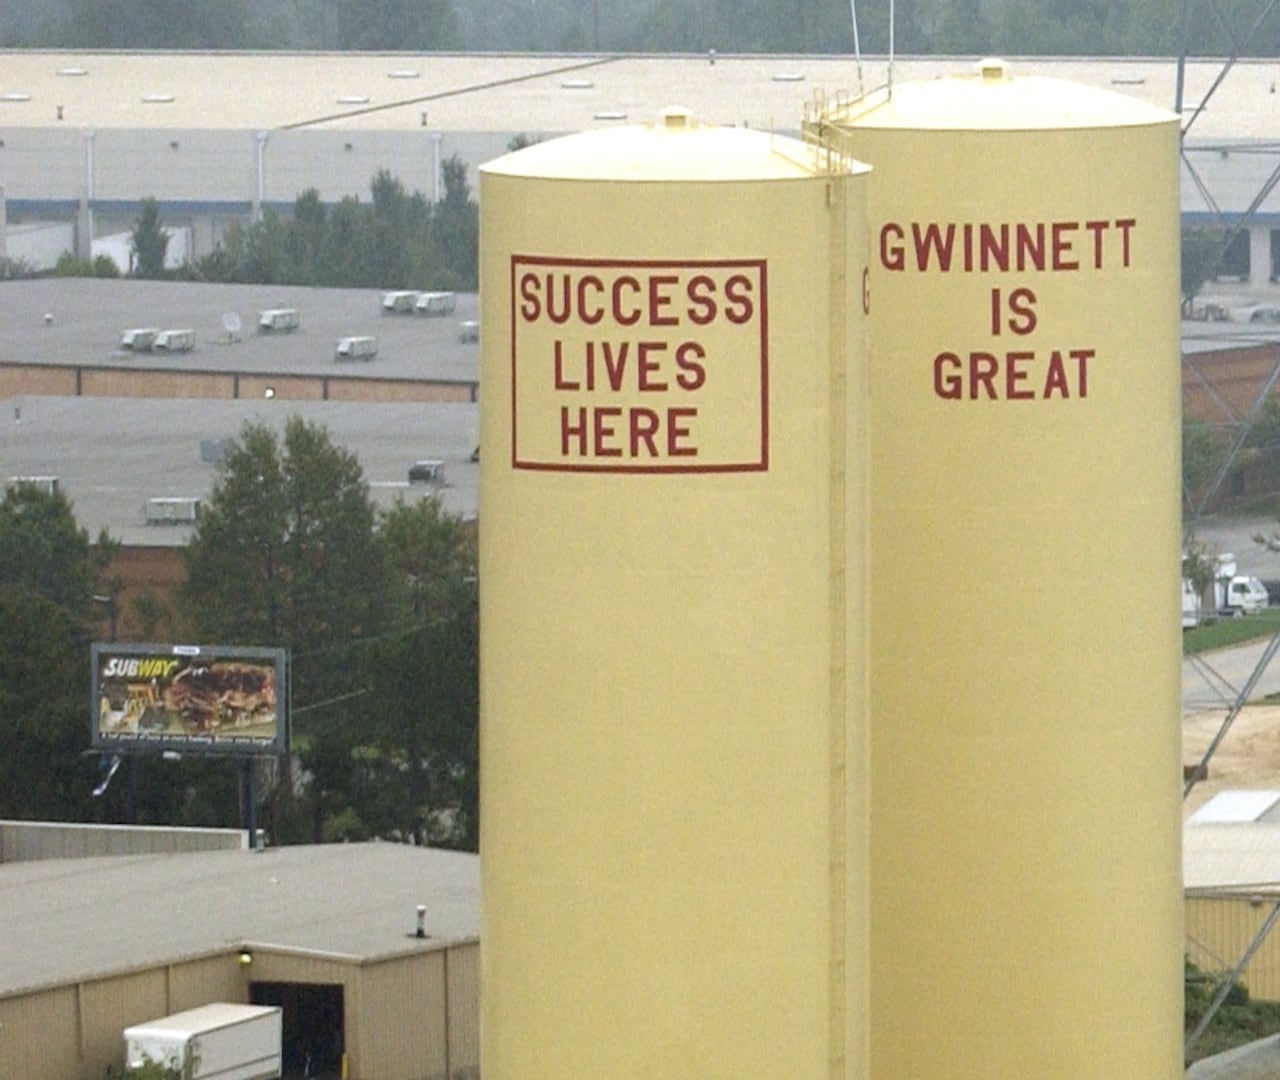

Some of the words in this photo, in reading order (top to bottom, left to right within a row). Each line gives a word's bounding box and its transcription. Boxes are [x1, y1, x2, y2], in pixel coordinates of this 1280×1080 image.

[880, 219, 1136, 273] GWINNETT
[521, 273, 754, 326] SUCCESS
[991, 287, 1037, 336] IS
[554, 340, 706, 391] LIVES
[934, 349, 1096, 400] GREAT
[561, 406, 698, 457] HERE
[104, 658, 178, 678] SUBWAY
